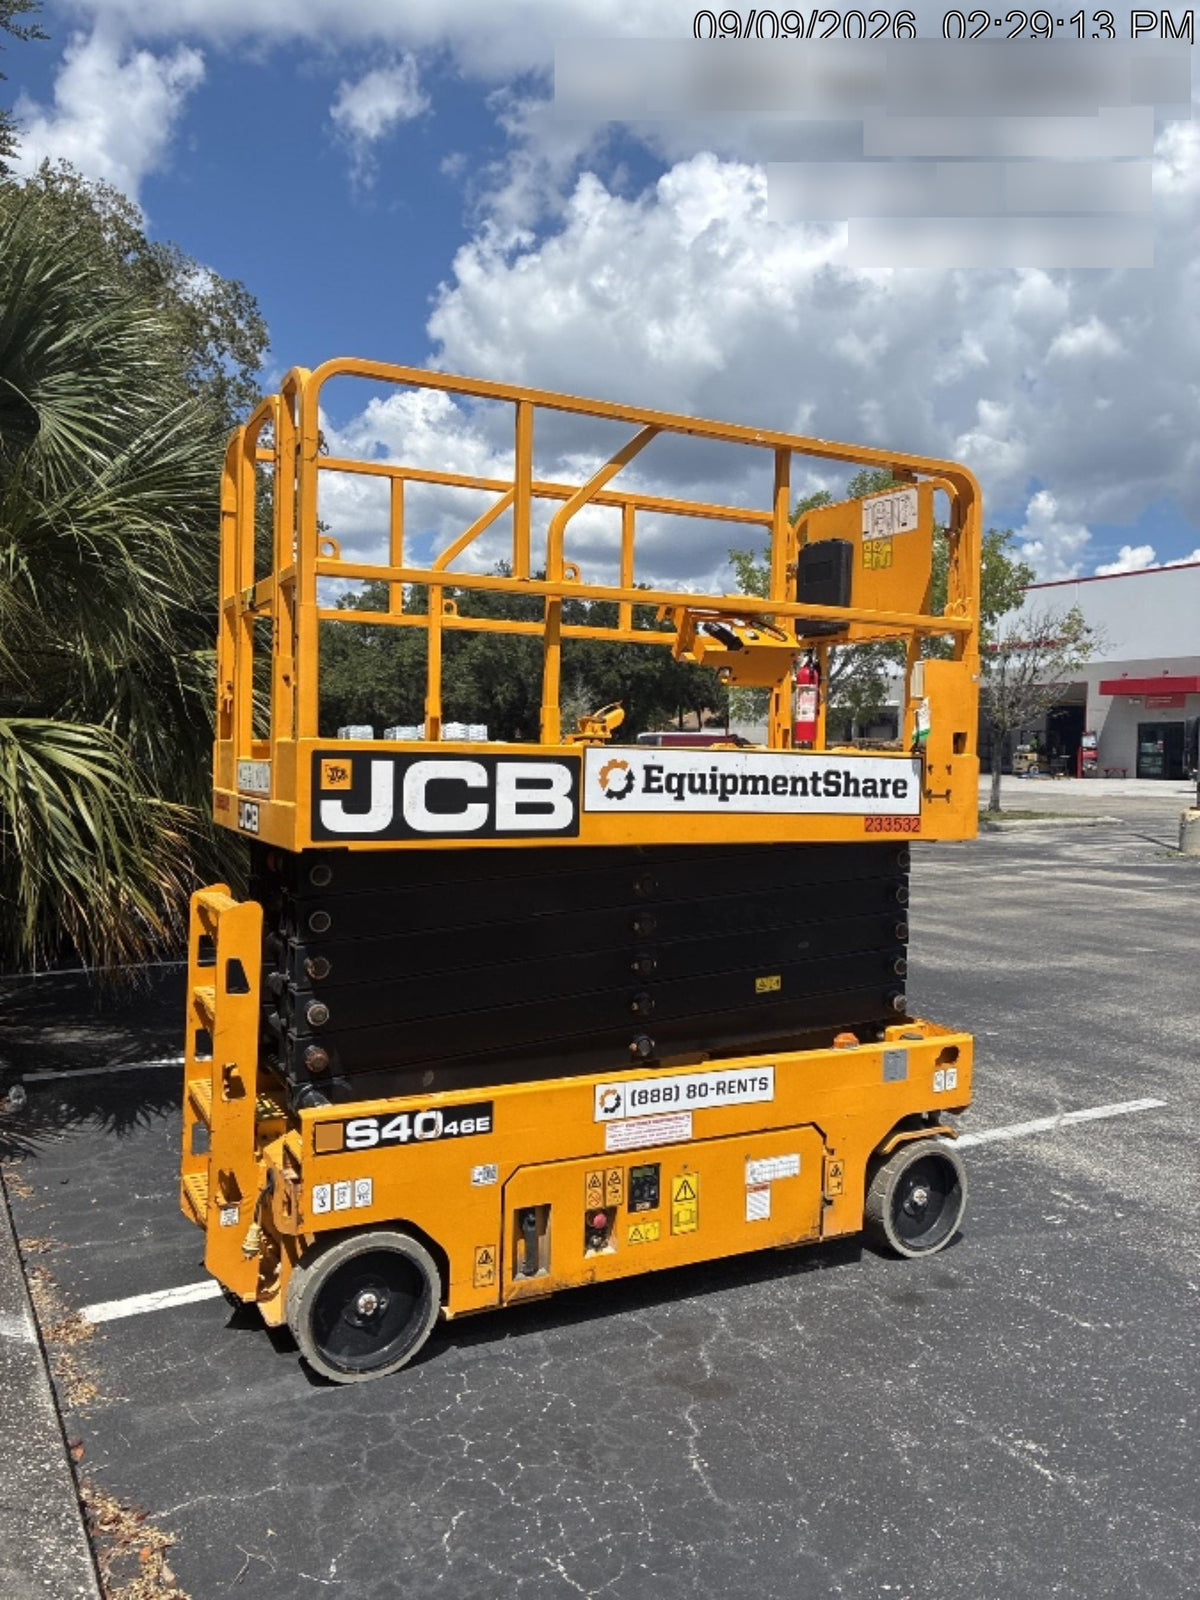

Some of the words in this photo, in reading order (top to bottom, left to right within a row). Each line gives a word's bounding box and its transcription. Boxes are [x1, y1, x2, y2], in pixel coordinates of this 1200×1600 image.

[320, 759, 574, 833] JCB
[642, 764, 908, 802] EquipmentShare
[239, 801, 259, 833] JCB
[865, 817, 921, 832] 233532
[631, 1085, 680, 1107] (888)
[686, 1077, 769, 1099] 80-RENTS
